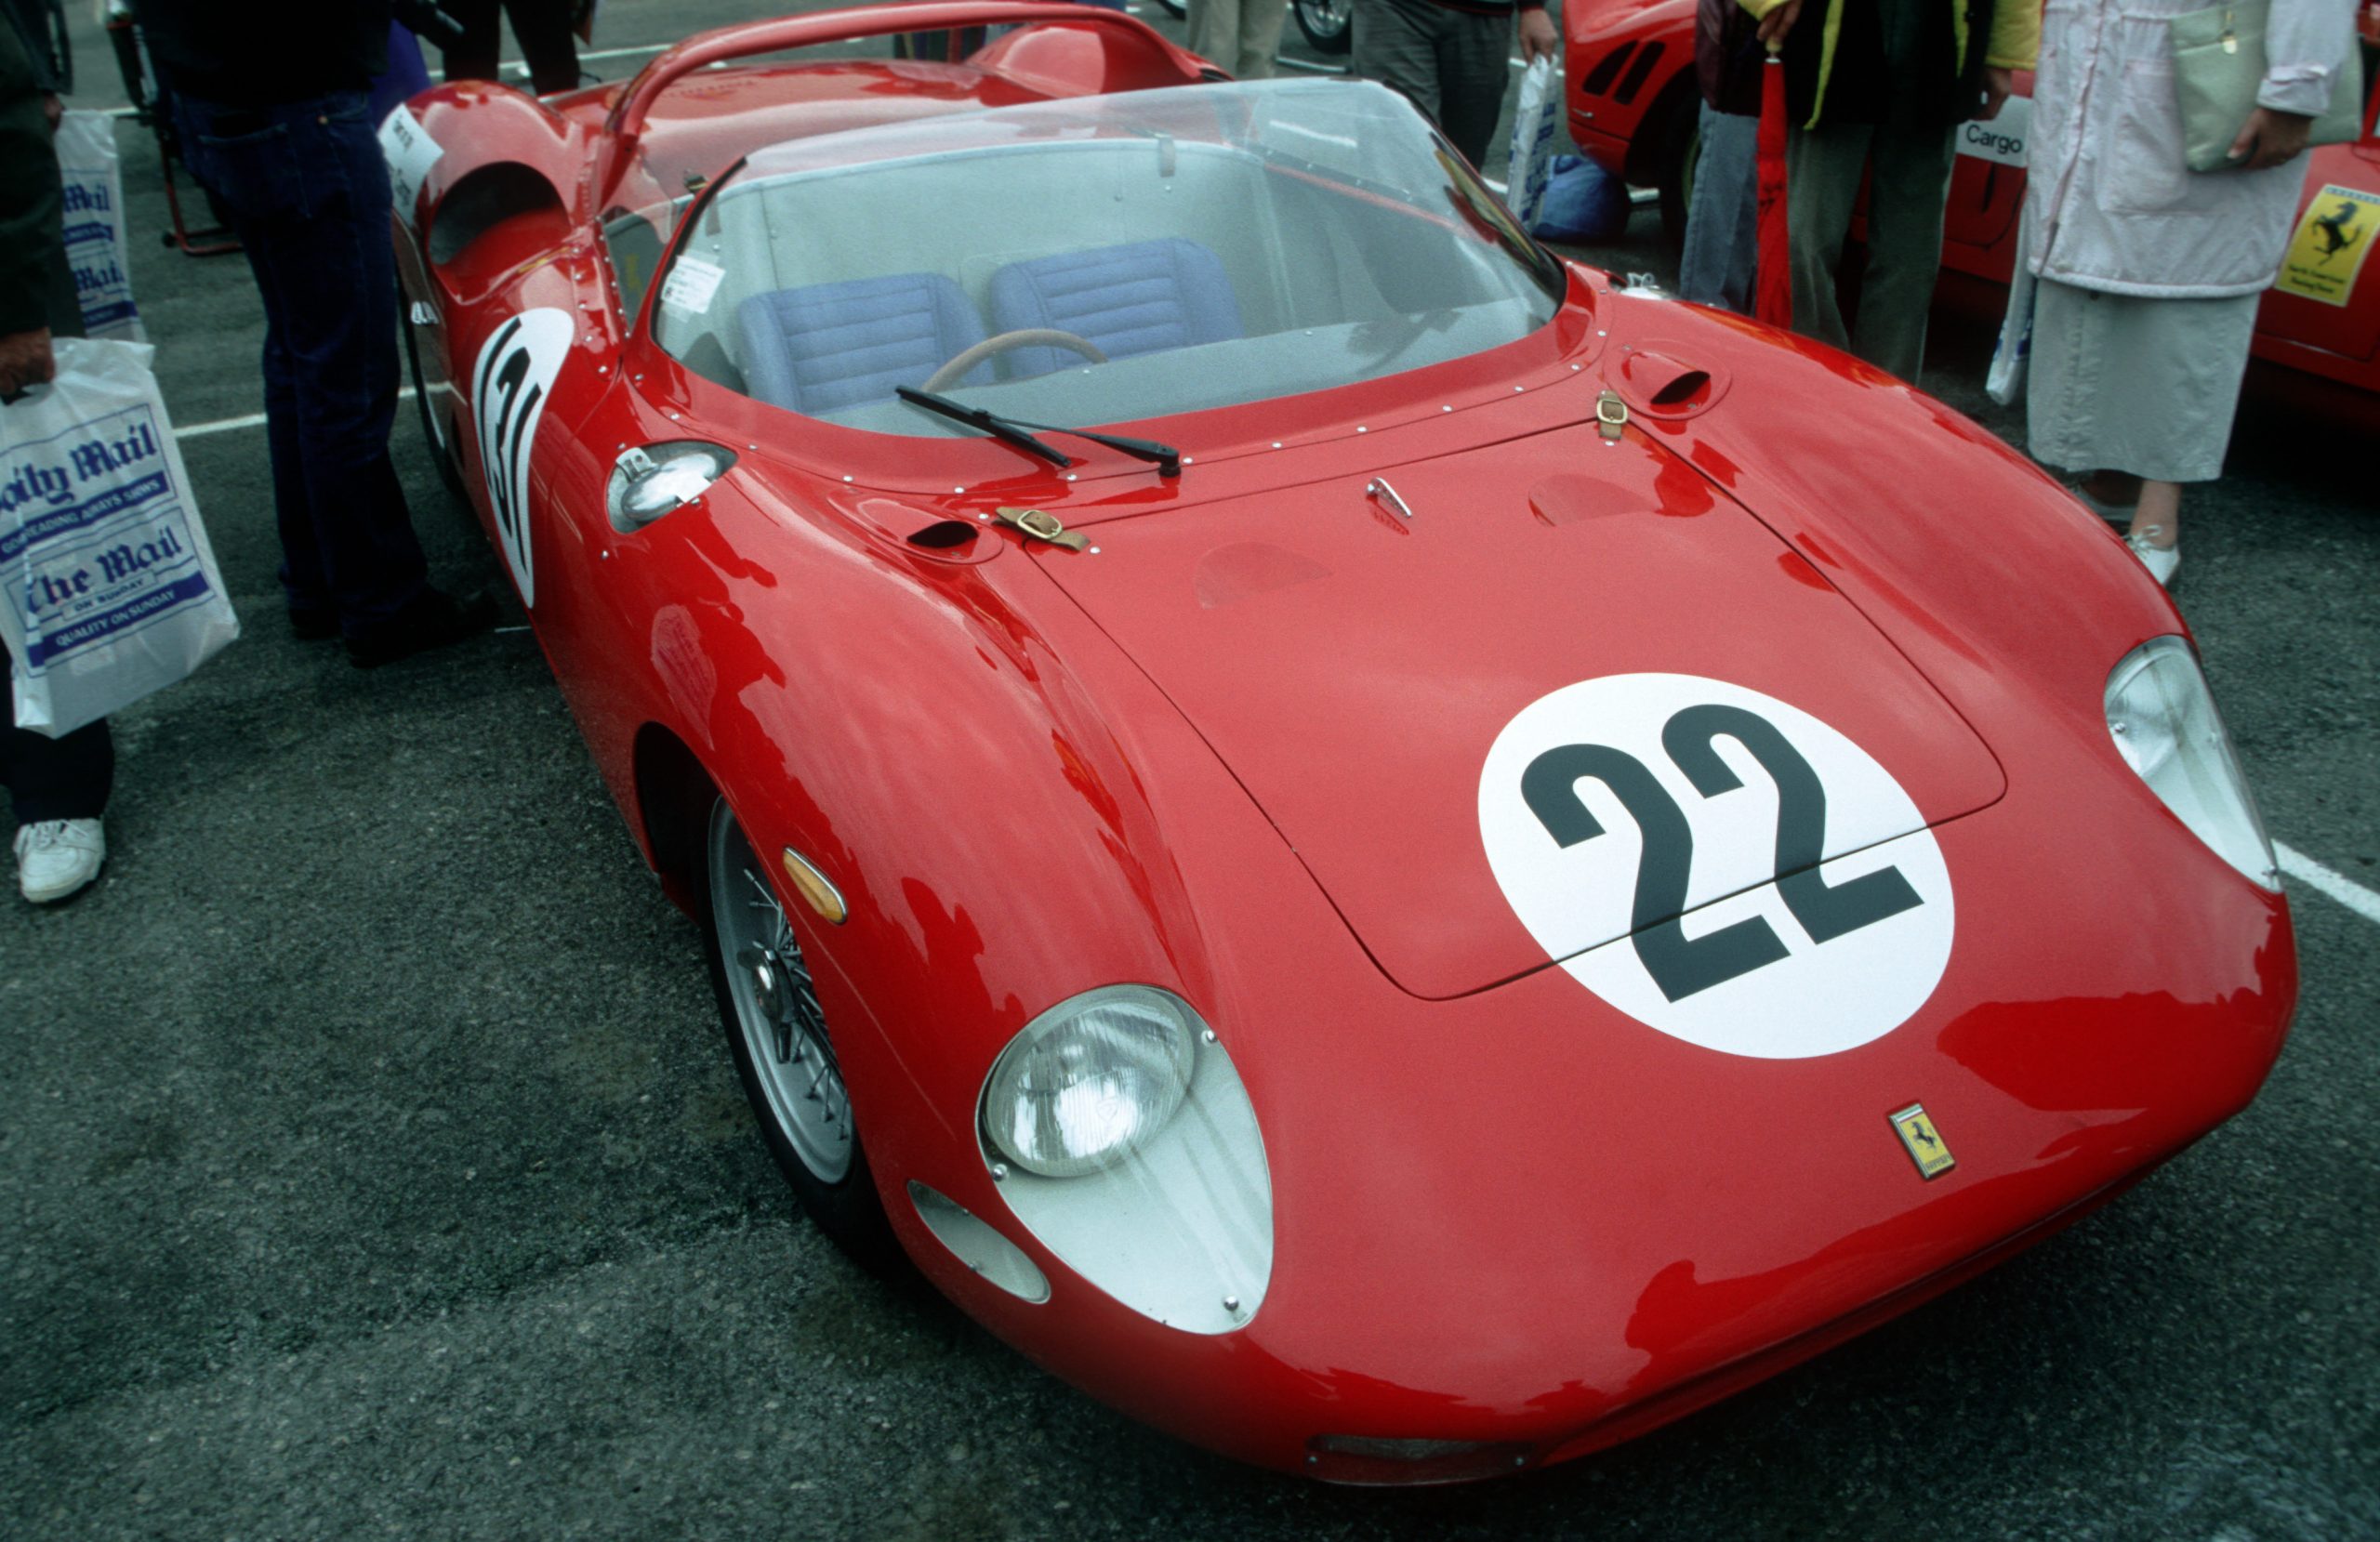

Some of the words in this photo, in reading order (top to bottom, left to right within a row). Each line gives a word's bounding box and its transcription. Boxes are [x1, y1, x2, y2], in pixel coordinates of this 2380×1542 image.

[1966, 124, 2023, 155] Cargo
[0, 463, 75, 511] aily
[69, 423, 157, 481] Mail
[97, 525, 183, 584] Mail
[56, 619, 109, 647] QUALITY
[111, 607, 130, 626] ON
[130, 589, 176, 617] SUNDAY
[1521, 704, 1924, 1004] 22
